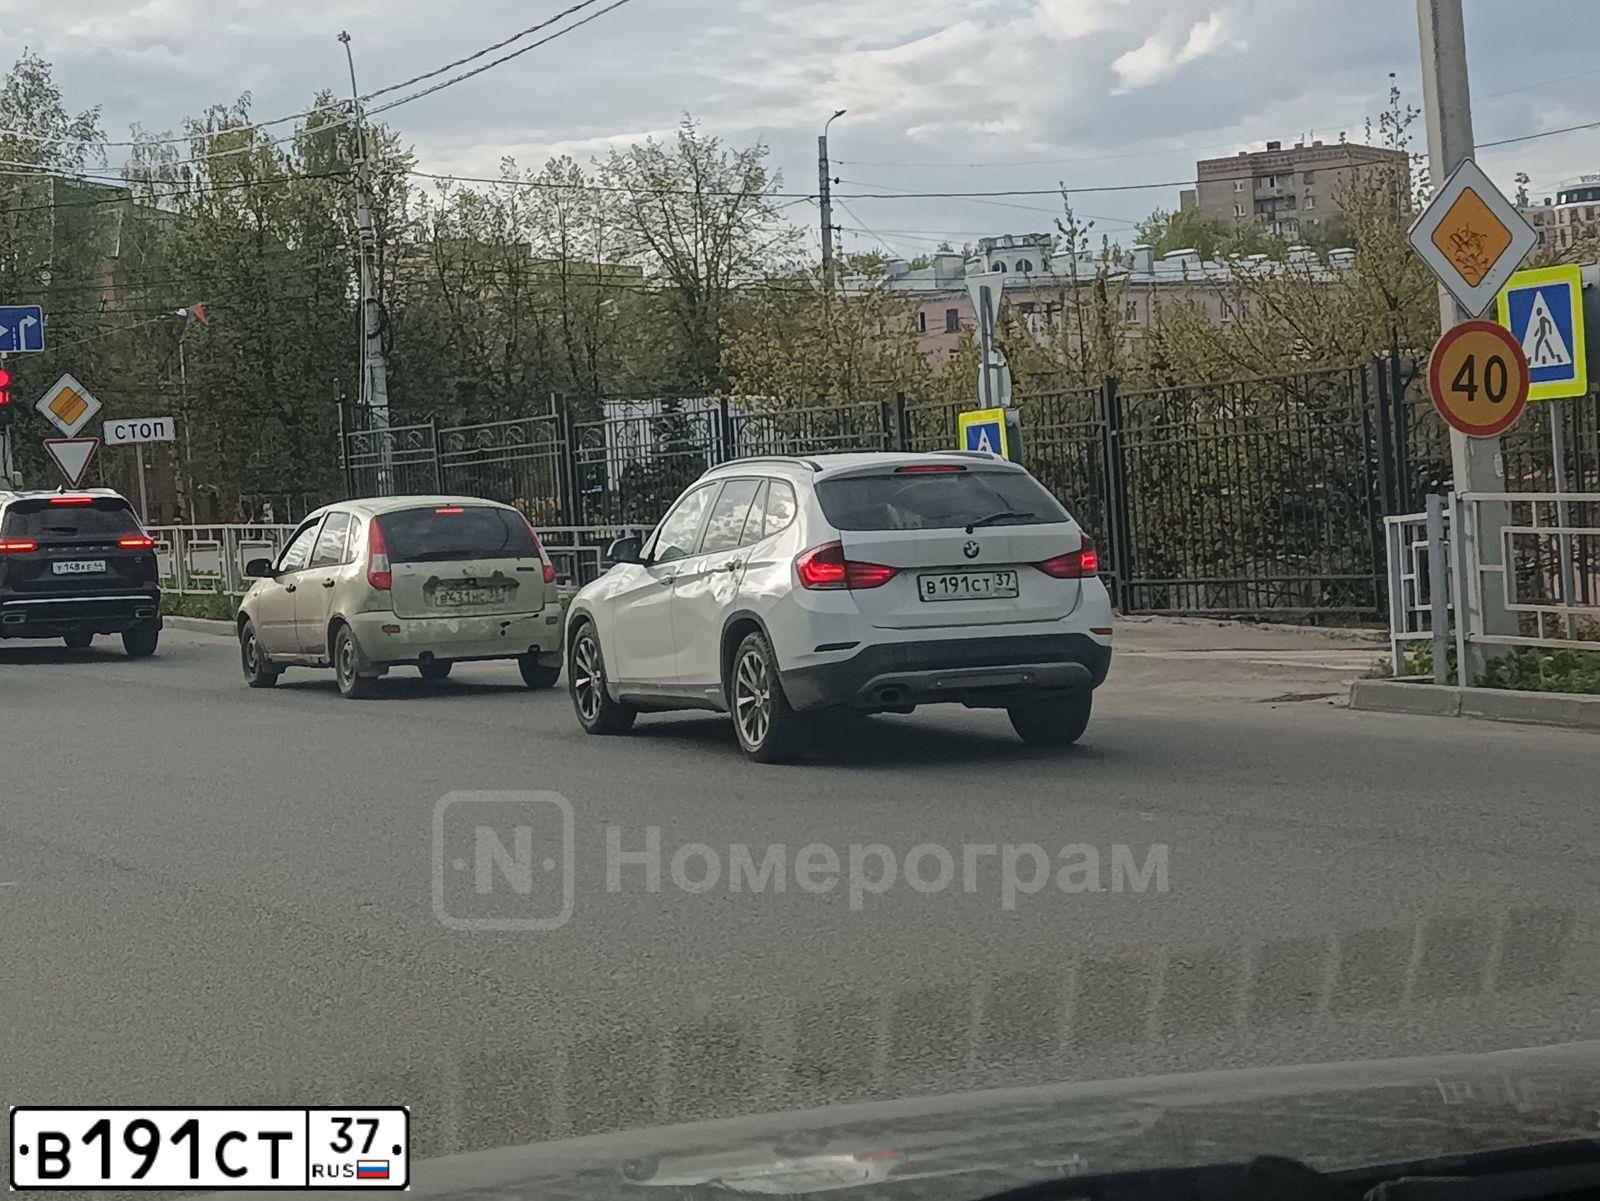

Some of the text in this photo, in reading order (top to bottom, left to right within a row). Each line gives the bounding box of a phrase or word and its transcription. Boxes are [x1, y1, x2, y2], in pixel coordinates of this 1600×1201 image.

[1452, 354, 1508, 403] 40
[115, 422, 164, 440] СТОП
[926, 576, 991, 595] В191СТ
[996, 573, 1011, 587] 37
